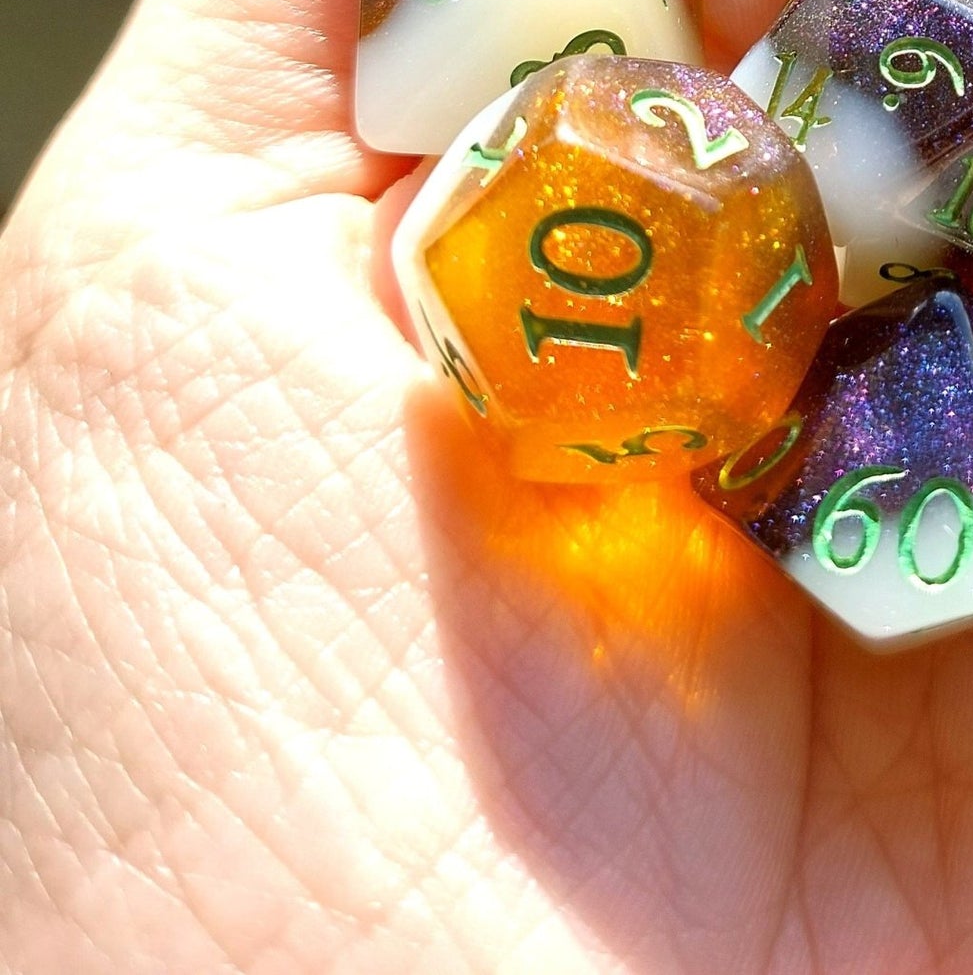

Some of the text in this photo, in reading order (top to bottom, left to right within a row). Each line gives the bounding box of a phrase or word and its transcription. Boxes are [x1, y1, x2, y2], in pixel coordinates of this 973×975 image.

[631, 88, 749, 169] 2
[766, 51, 833, 152] 14
[520, 206, 653, 380] 10
[742, 245, 813, 344] 1
